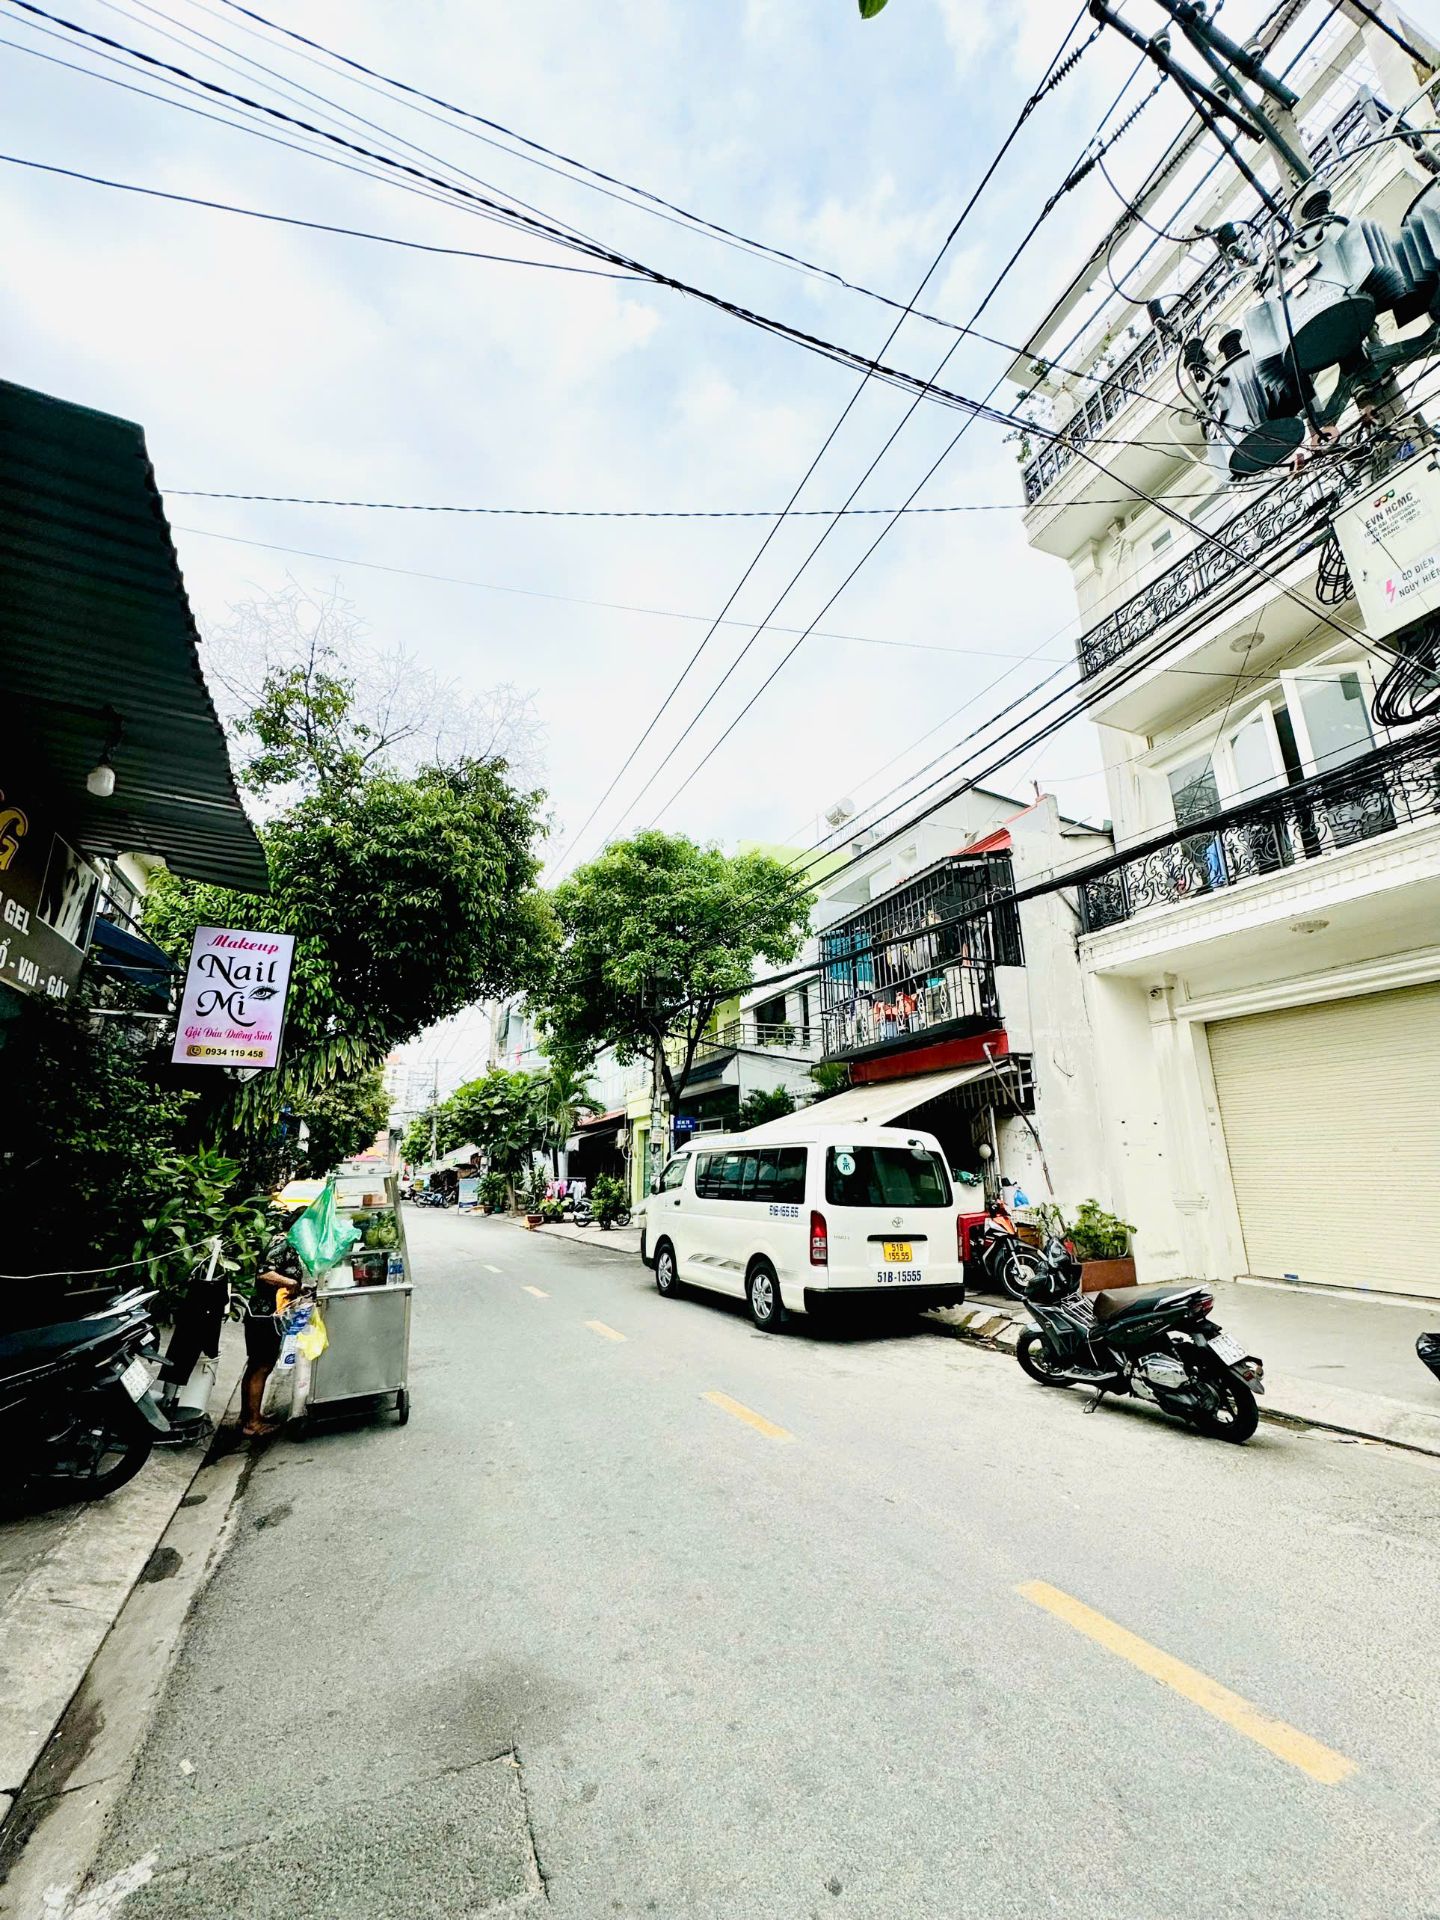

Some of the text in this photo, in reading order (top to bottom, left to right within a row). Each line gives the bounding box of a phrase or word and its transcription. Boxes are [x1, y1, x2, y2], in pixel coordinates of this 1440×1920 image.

[1365, 511, 1384, 529] EVN
[1385, 491, 1413, 516] HCMC
[1398, 580, 1420, 598] NGUY
[4, 898, 30, 936] GEL
[207, 934, 279, 955] Makeup
[17, 956, 39, 987] VAI
[197, 953, 278, 989] Nail
[195, 989, 257, 1027] Mi
[254, 1030, 273, 1041] Sinh
[205, 1047, 264, 1058] 0934 119 458
[891, 1243, 904, 1252] 51B
[877, 1270, 922, 1283] 51B-15555
